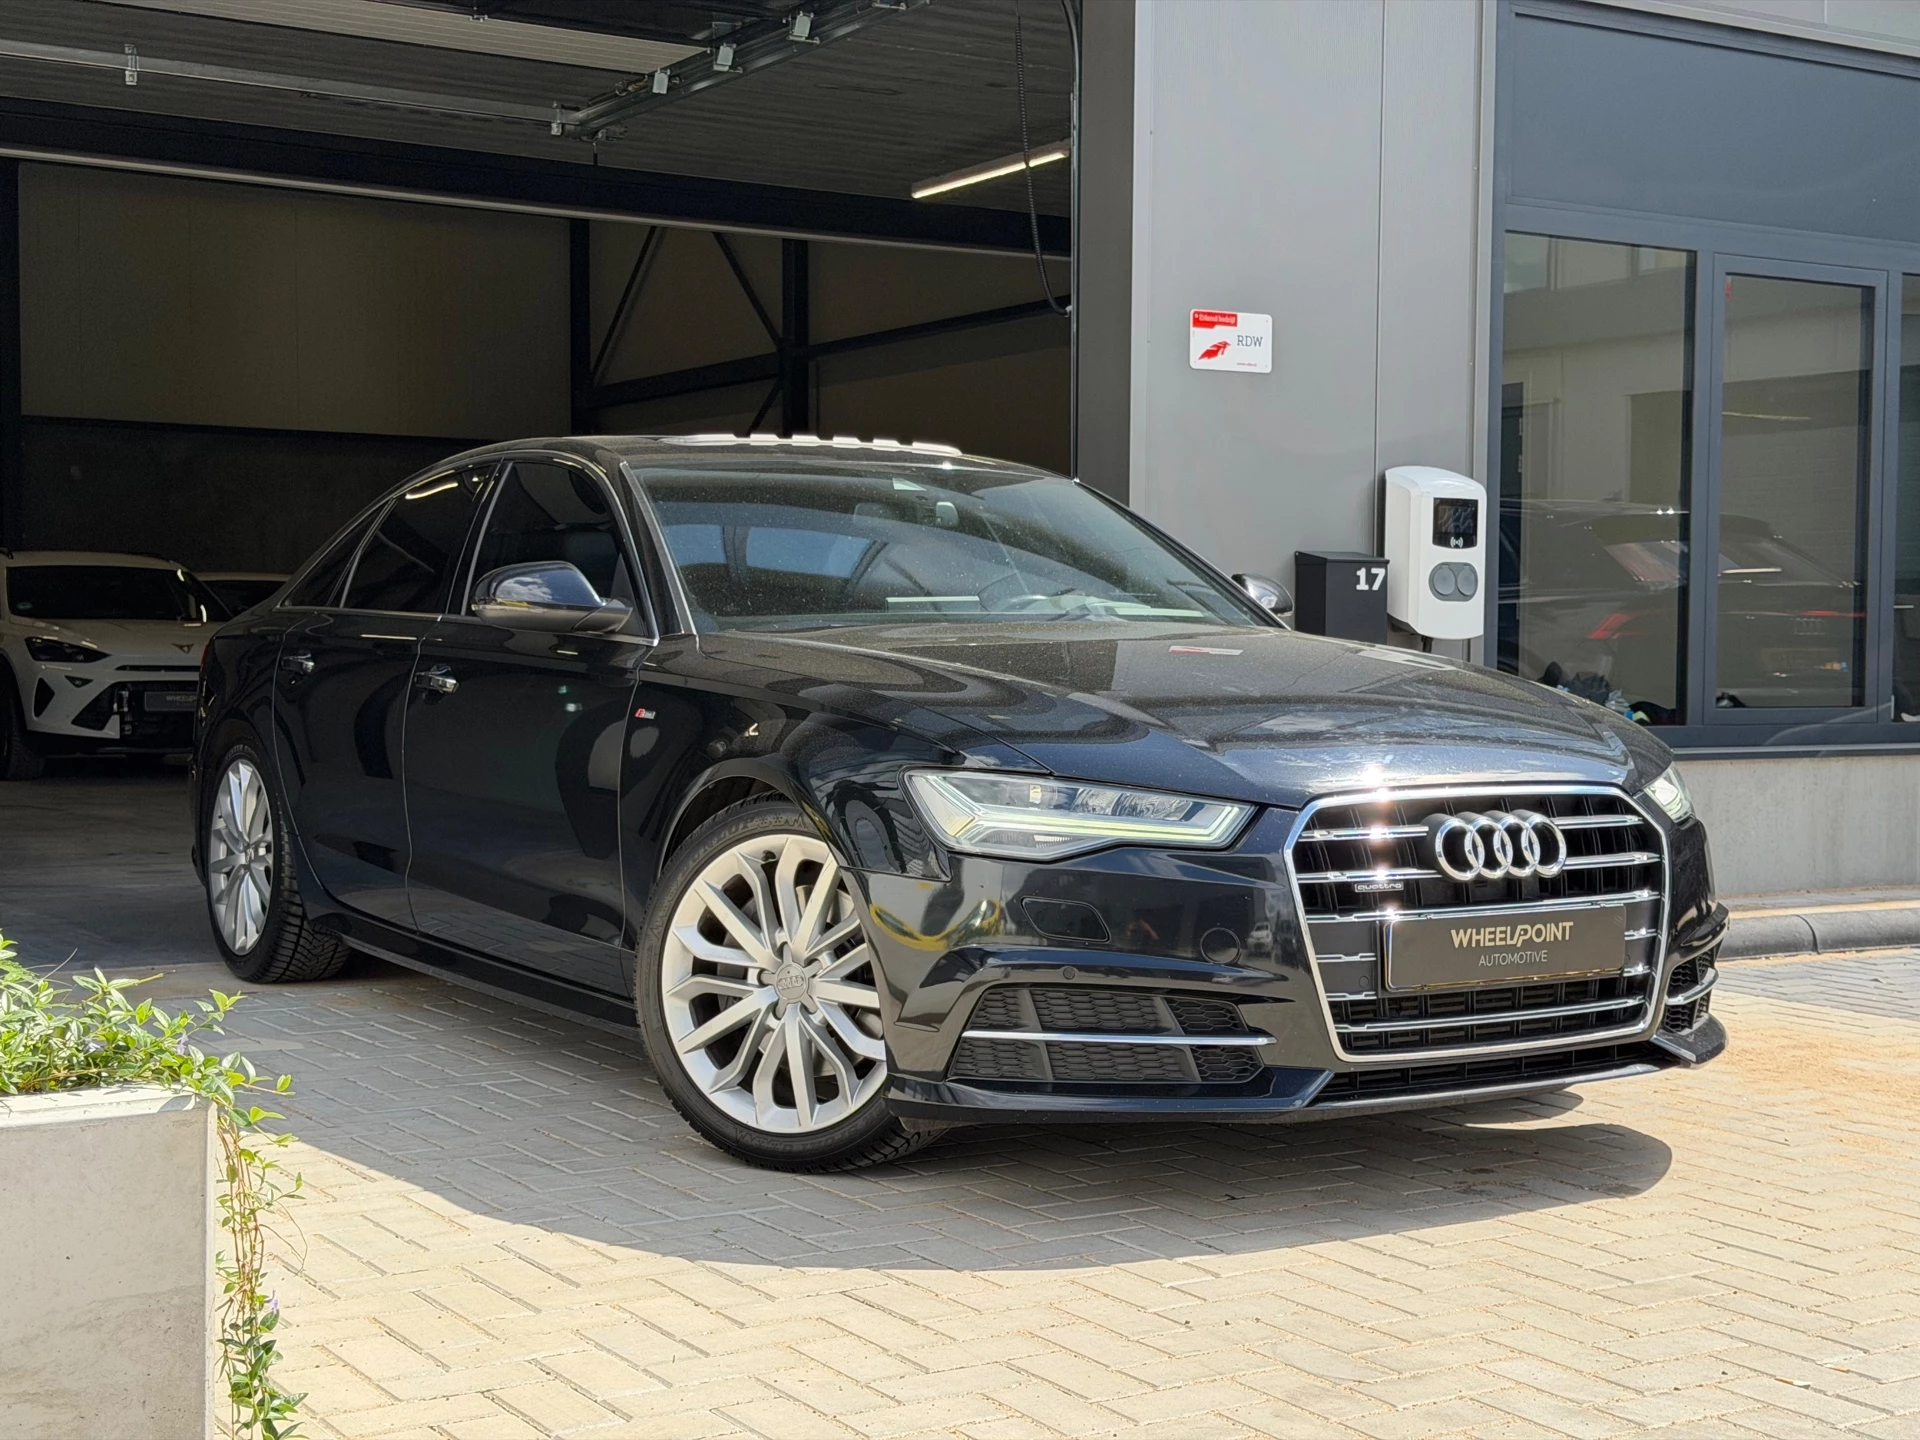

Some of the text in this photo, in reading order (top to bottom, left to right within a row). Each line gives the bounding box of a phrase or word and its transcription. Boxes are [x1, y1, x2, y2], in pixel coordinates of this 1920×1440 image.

[1236, 335, 1263, 347] RDW
[1356, 567, 1386, 591] 17
[1357, 883, 1402, 892] quattro
[1451, 921, 1574, 949] WHEELPOINT
[1478, 950, 1548, 967] AUTOMOTIVE
